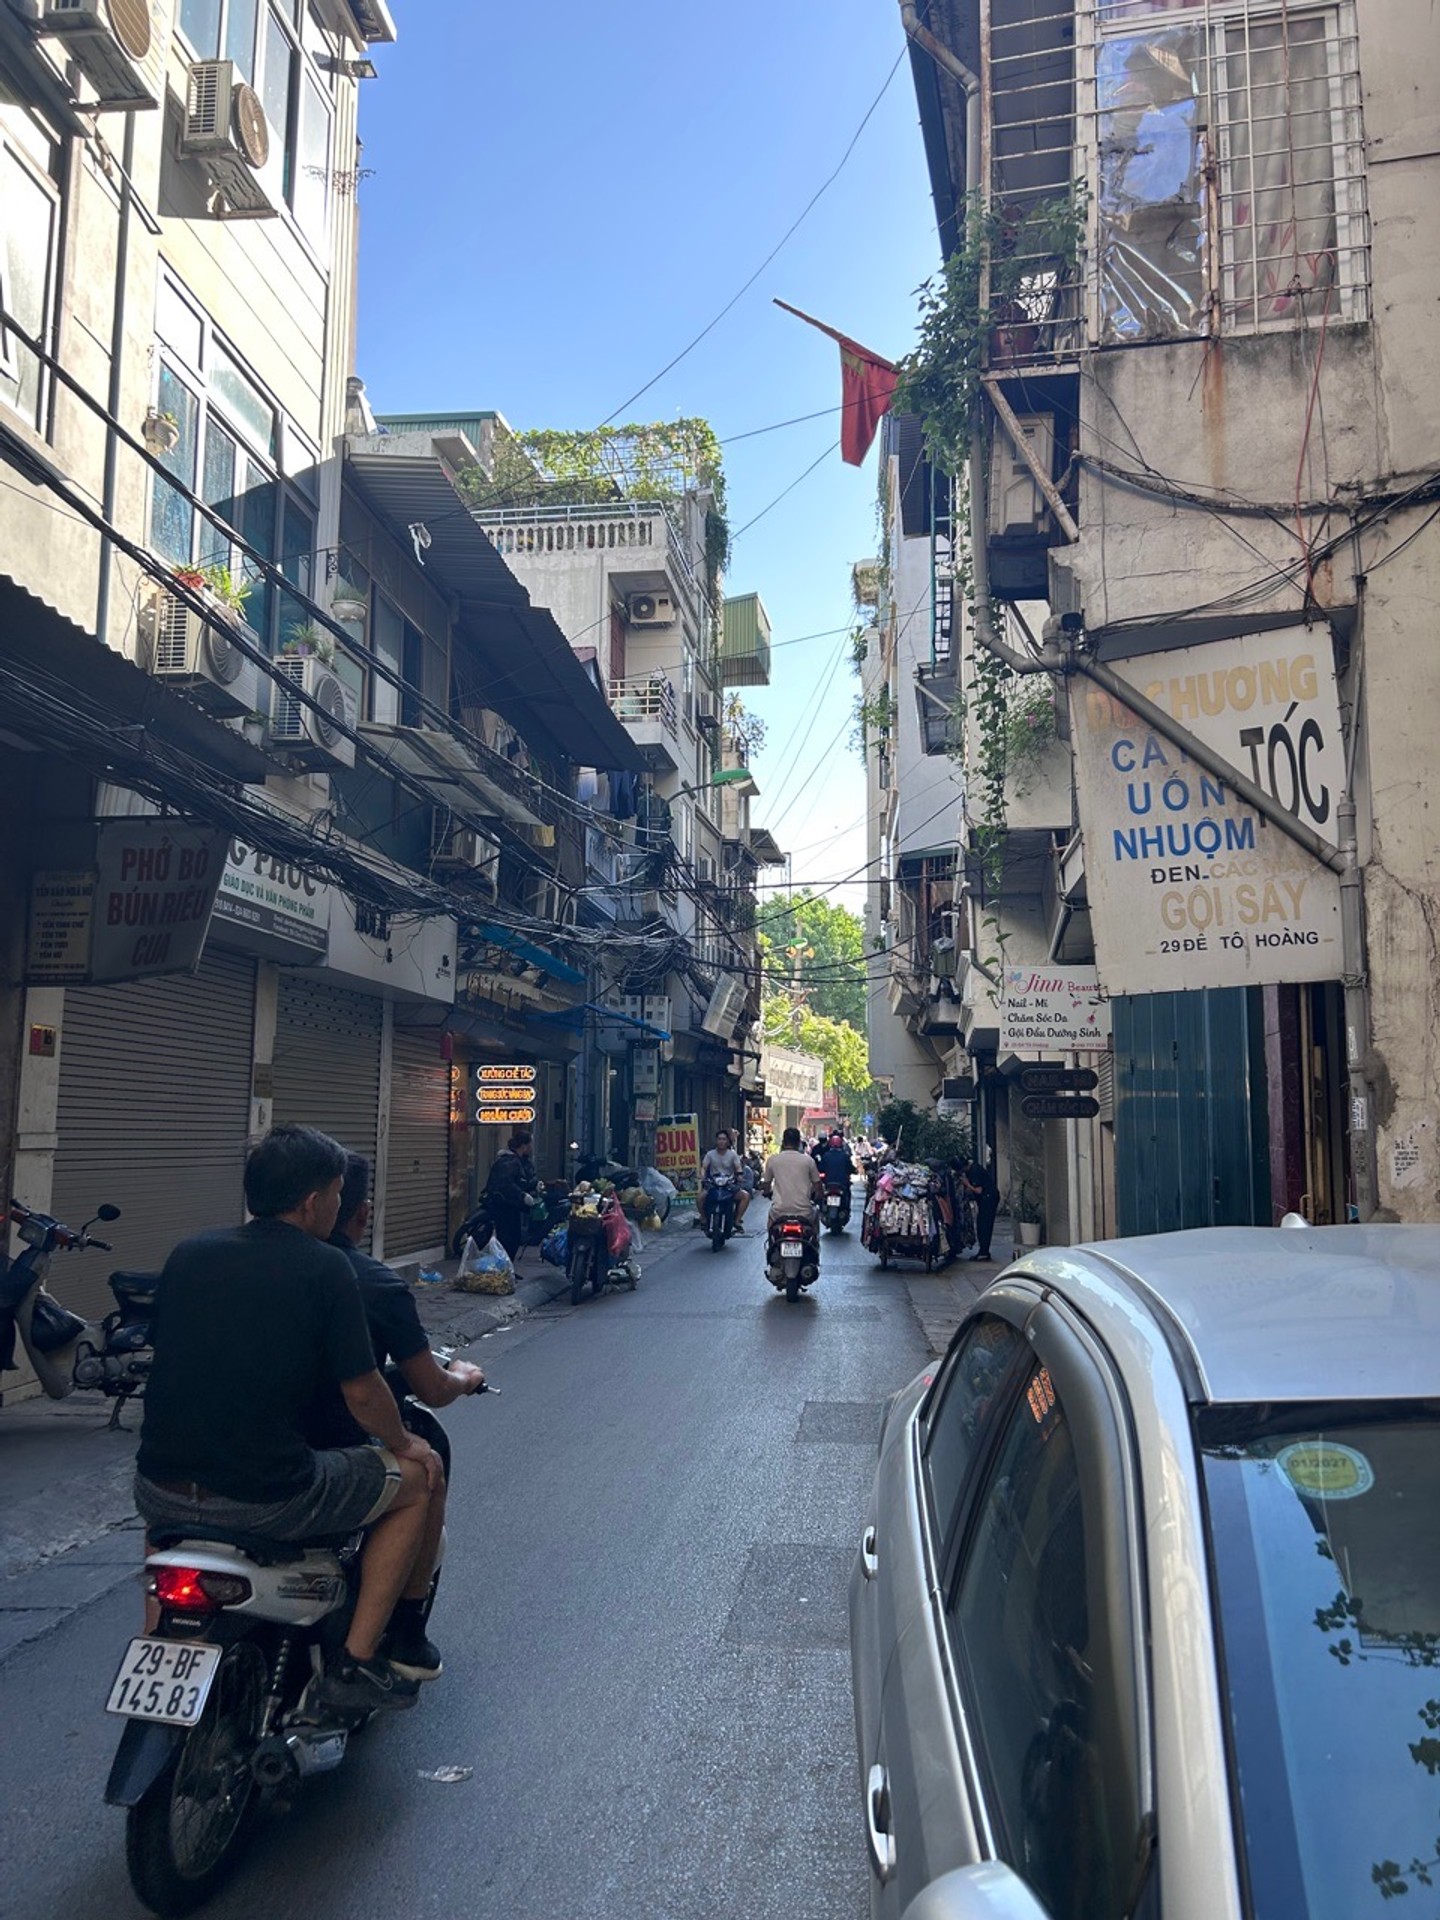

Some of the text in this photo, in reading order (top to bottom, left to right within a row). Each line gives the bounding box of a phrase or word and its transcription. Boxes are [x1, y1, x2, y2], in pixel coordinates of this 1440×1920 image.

[1239, 701, 1330, 828] TÓC
[1127, 770, 1250, 815] UỐN
[1113, 816, 1256, 861] NHUỘM
[120, 836, 173, 883] PHỞ
[107, 886, 161, 927] BÚN
[131, 933, 173, 967] CUA
[1219, 931, 1245, 950] TÔ
[1255, 927, 1320, 948] HOÀNG
[1008, 998, 1028, 1008] Nail
[1067, 981, 1101, 992] Beaut
[1036, 1012, 1053, 1023] Sóc
[1054, 1012, 1068, 1023] Da
[1079, 1027, 1102, 1038] Sinh
[131, 1643, 206, 1681] 29-BF
[115, 1677, 202, 1718] 145.83
